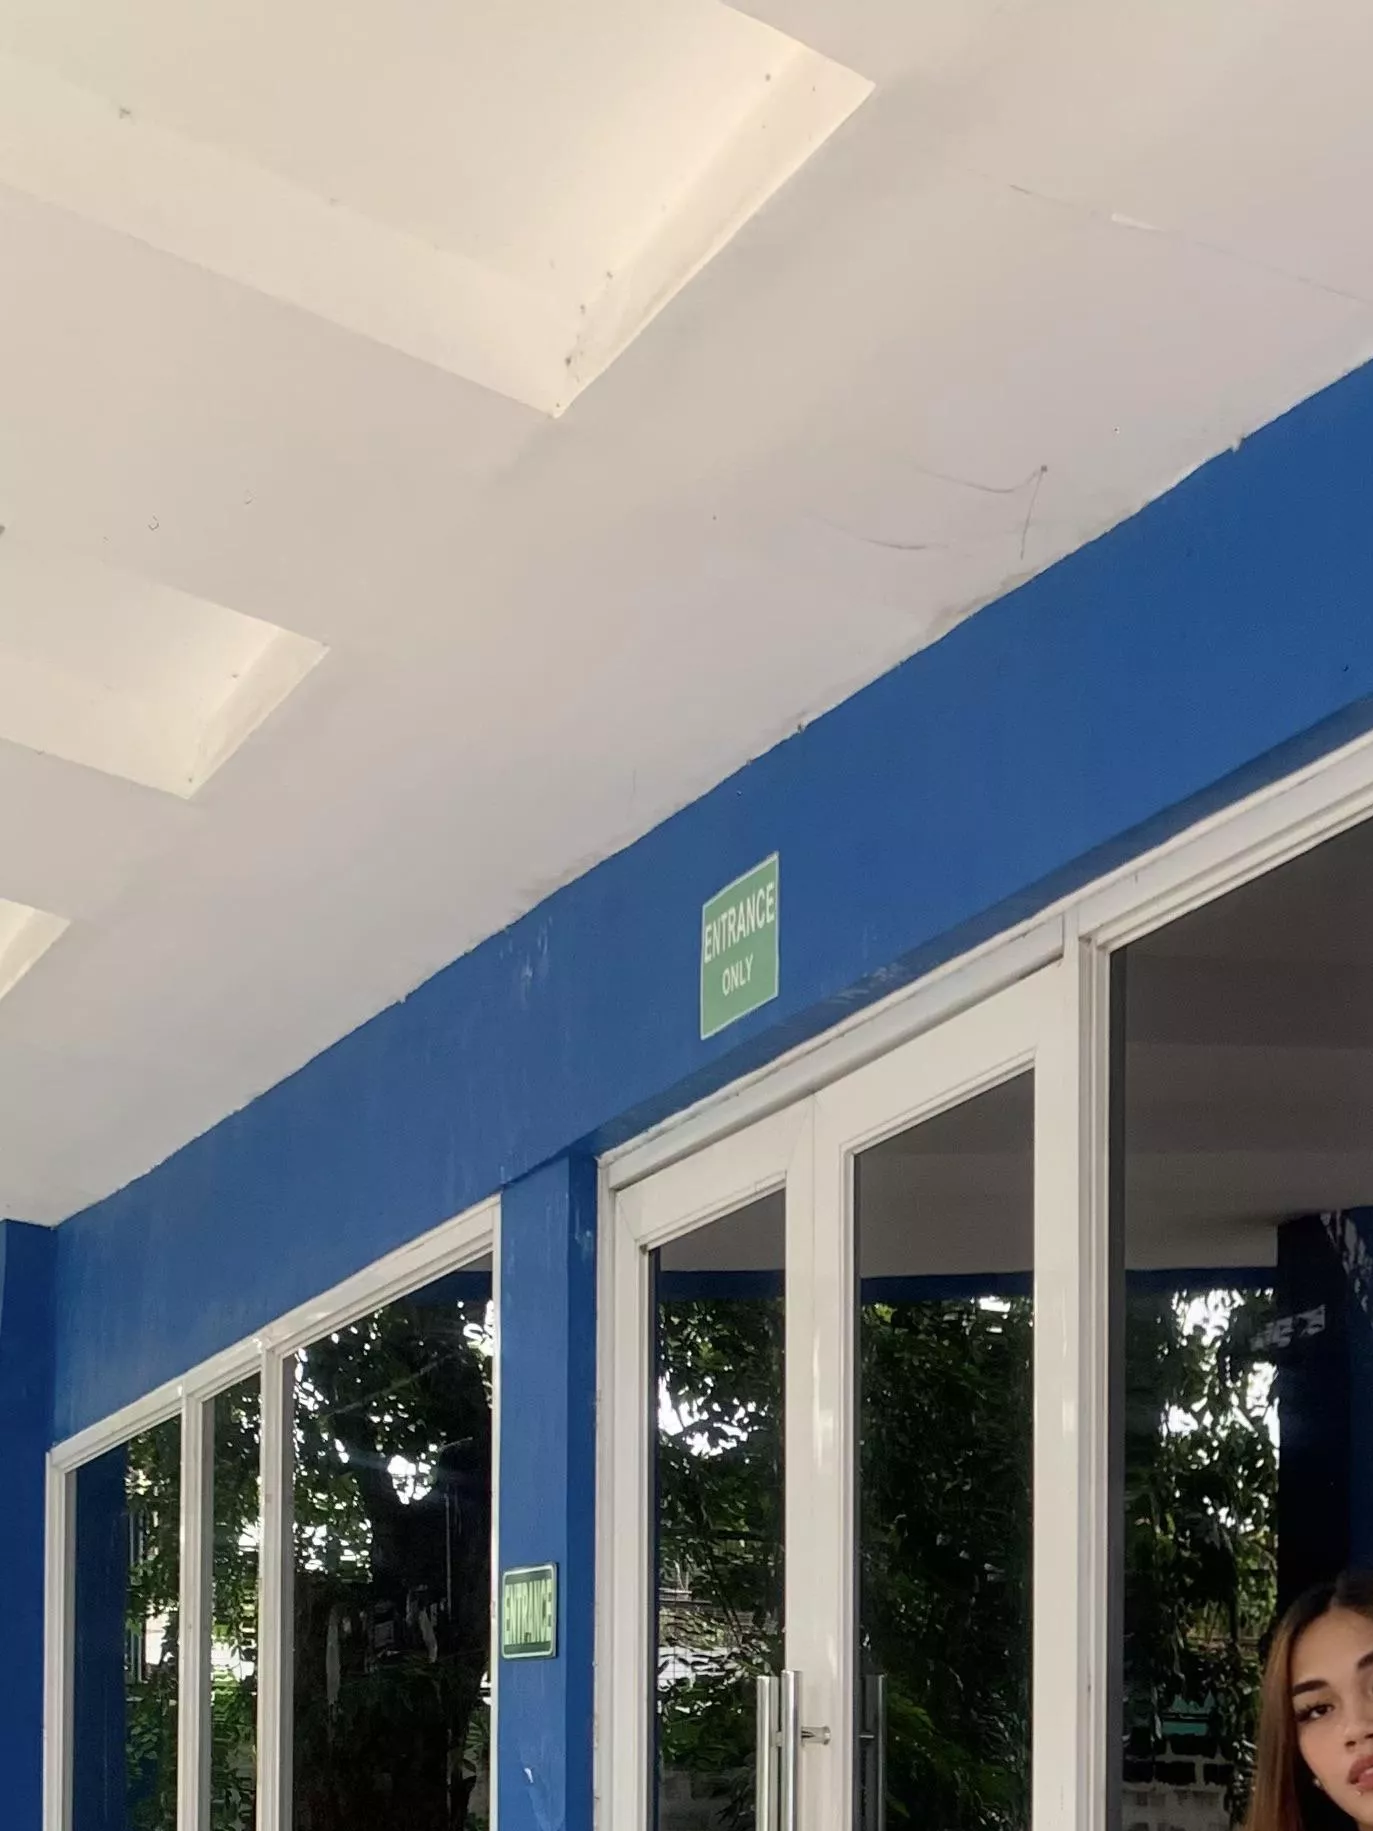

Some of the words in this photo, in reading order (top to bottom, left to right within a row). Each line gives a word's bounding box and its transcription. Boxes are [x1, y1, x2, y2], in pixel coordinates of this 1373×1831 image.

[704, 881, 775, 964] ENTRANCE
[721, 953, 754, 996] ONLY
[504, 1578, 552, 1645] ENTRANCE
